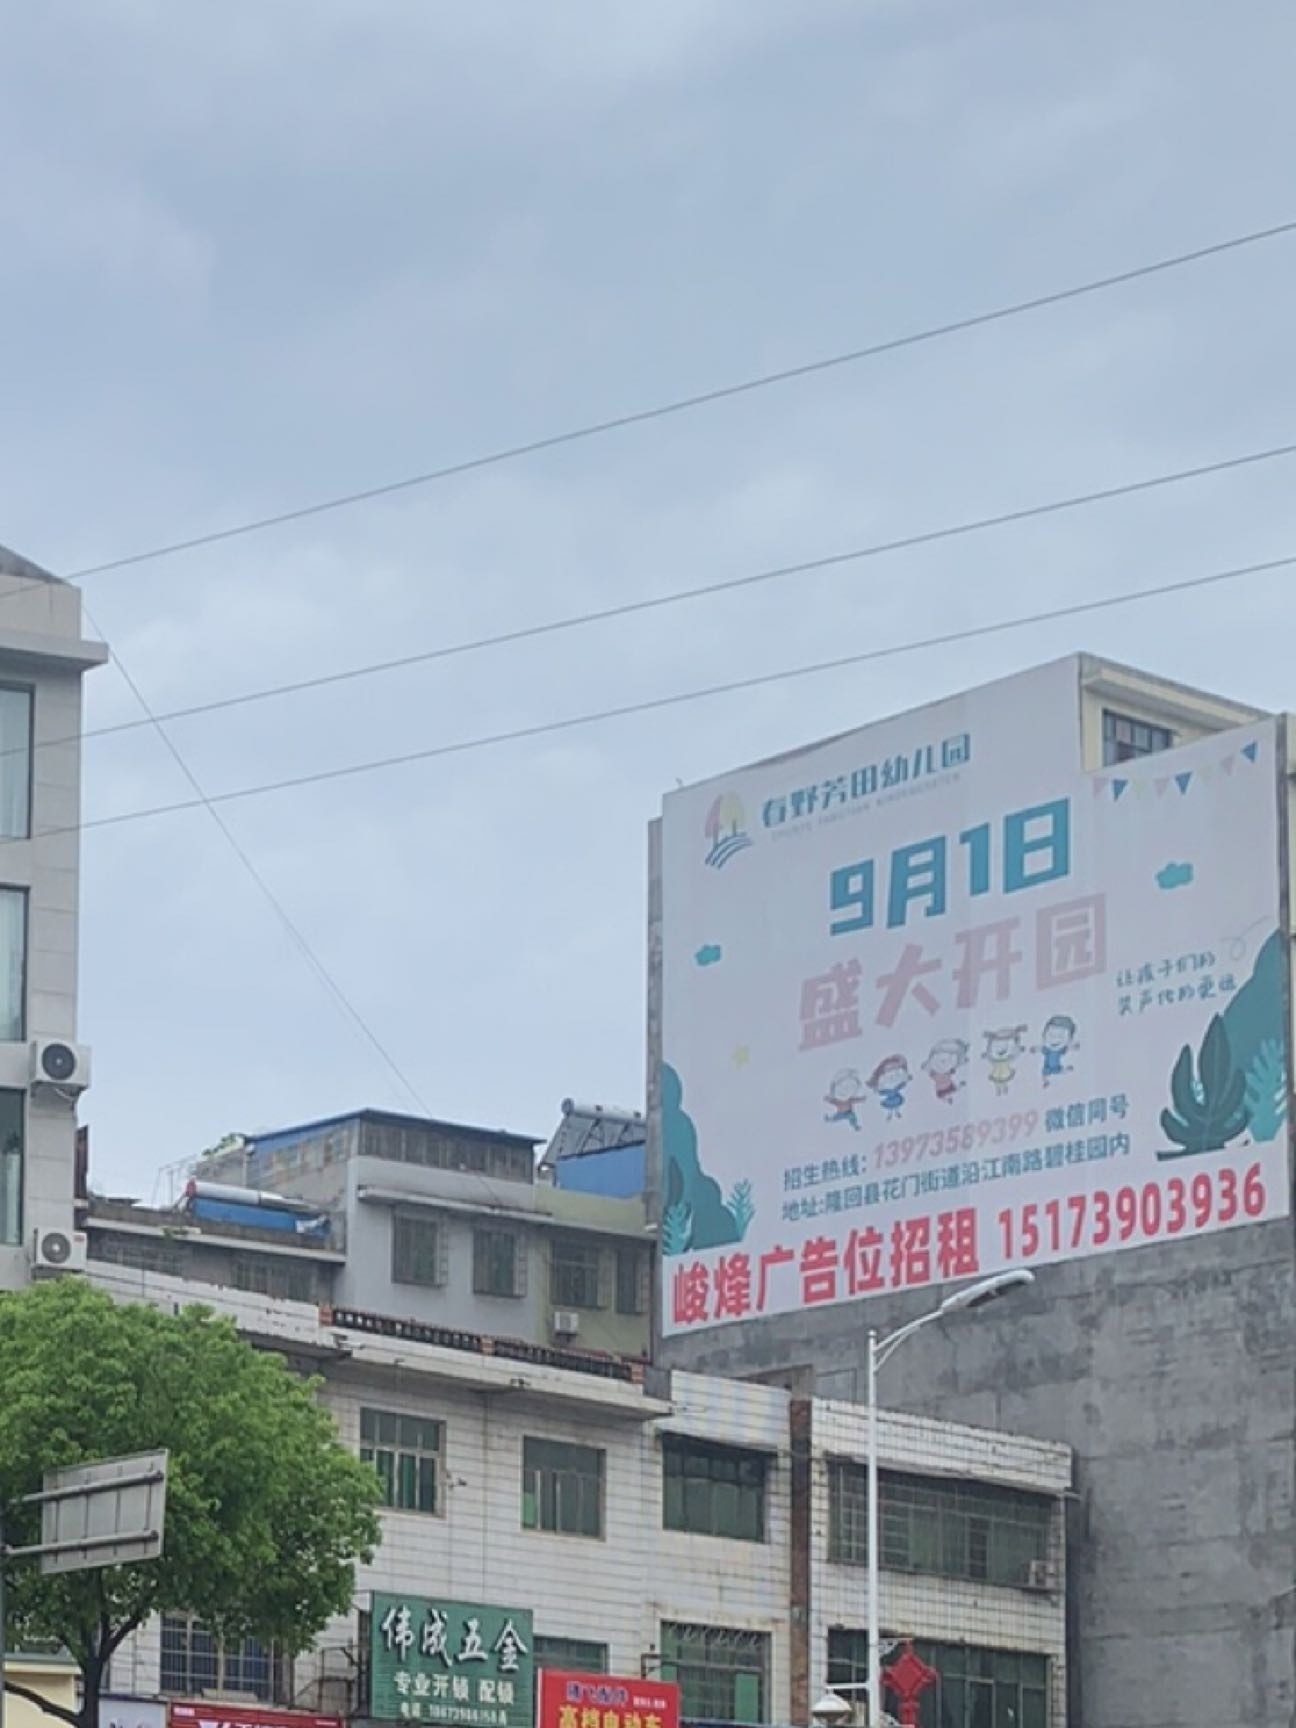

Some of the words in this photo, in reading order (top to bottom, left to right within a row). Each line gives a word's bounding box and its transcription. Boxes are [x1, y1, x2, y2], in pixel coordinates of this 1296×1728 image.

[829, 797, 1071, 937] 9月1日
[799, 892, 1106, 1052] 盛大开园
[1045, 1093, 1130, 1132] 微信同号
[998, 1162, 1267, 1260] 15173903936
